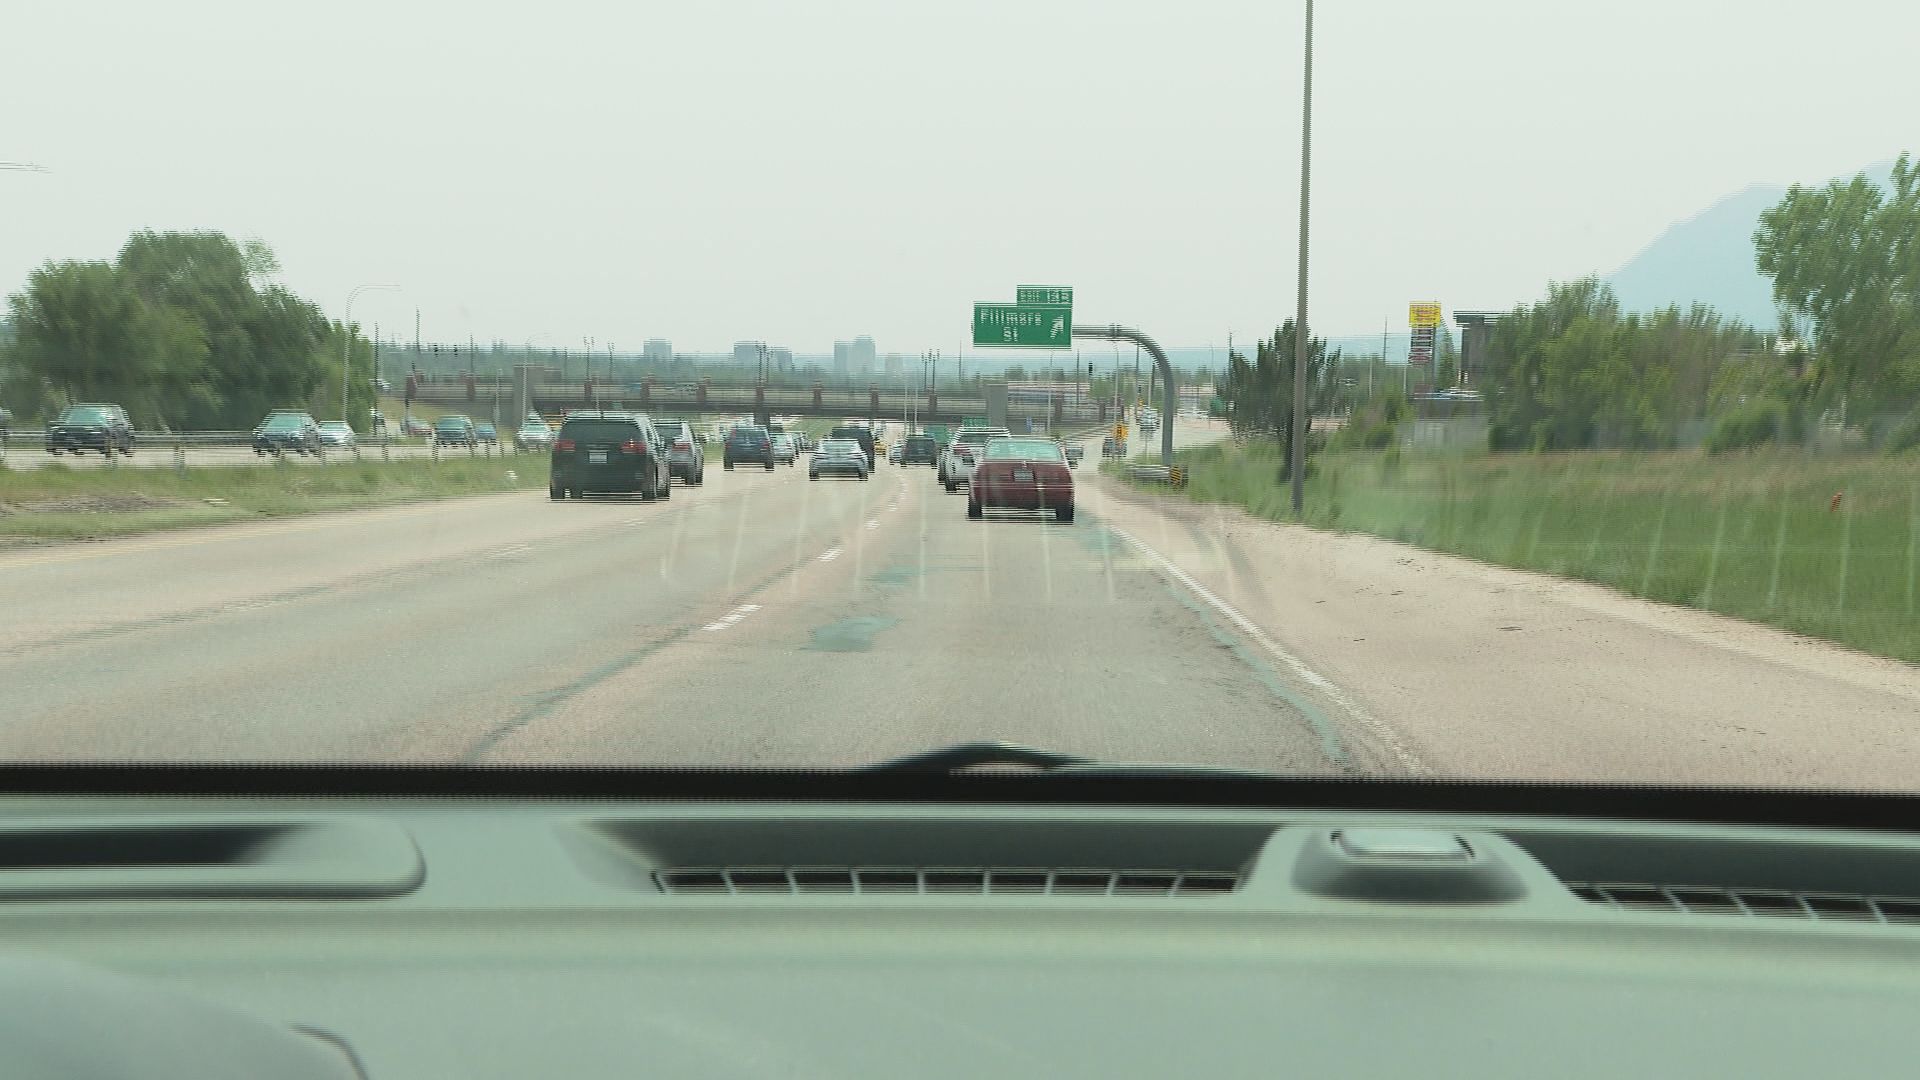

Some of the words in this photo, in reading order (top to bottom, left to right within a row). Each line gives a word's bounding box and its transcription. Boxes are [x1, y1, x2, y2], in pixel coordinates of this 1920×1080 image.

[1020, 290, 1040, 302] EXIT
[1047, 289, 1070, 304] 145
[980, 308, 1042, 325] Fillmore
[1003, 326, 1018, 341] St
